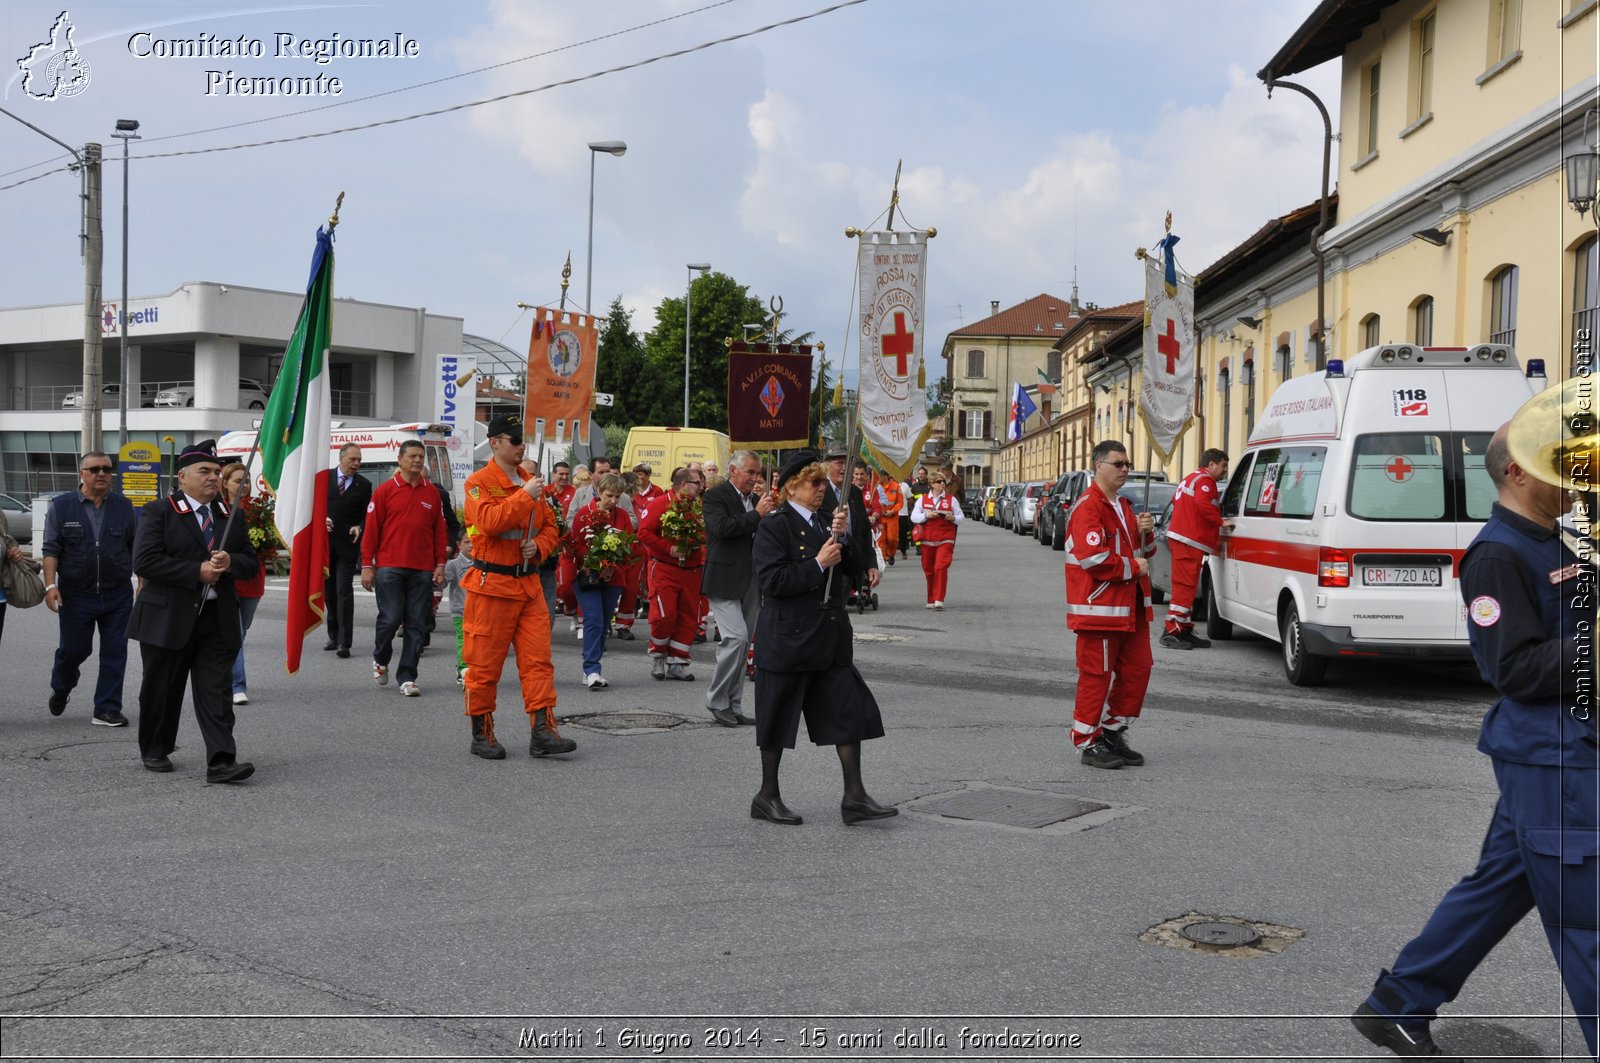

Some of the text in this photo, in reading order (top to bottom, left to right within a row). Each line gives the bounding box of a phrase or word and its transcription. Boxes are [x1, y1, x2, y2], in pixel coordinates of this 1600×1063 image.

[876, 267, 905, 291] ROSSA
[764, 363, 803, 390] COMUNALE
[1397, 389, 1427, 401] 118
[1270, 402, 1289, 418] CROCE
[1288, 399, 1306, 415] ROSSA
[759, 418, 784, 429] MATHI
[873, 412, 906, 427] COMITATO
[330, 434, 373, 443] ITALIANA
[1266, 463, 1279, 482] 118
[1367, 569, 1437, 583] CRI 720 AC
[1352, 613, 1405, 621] TRANSPORTER
